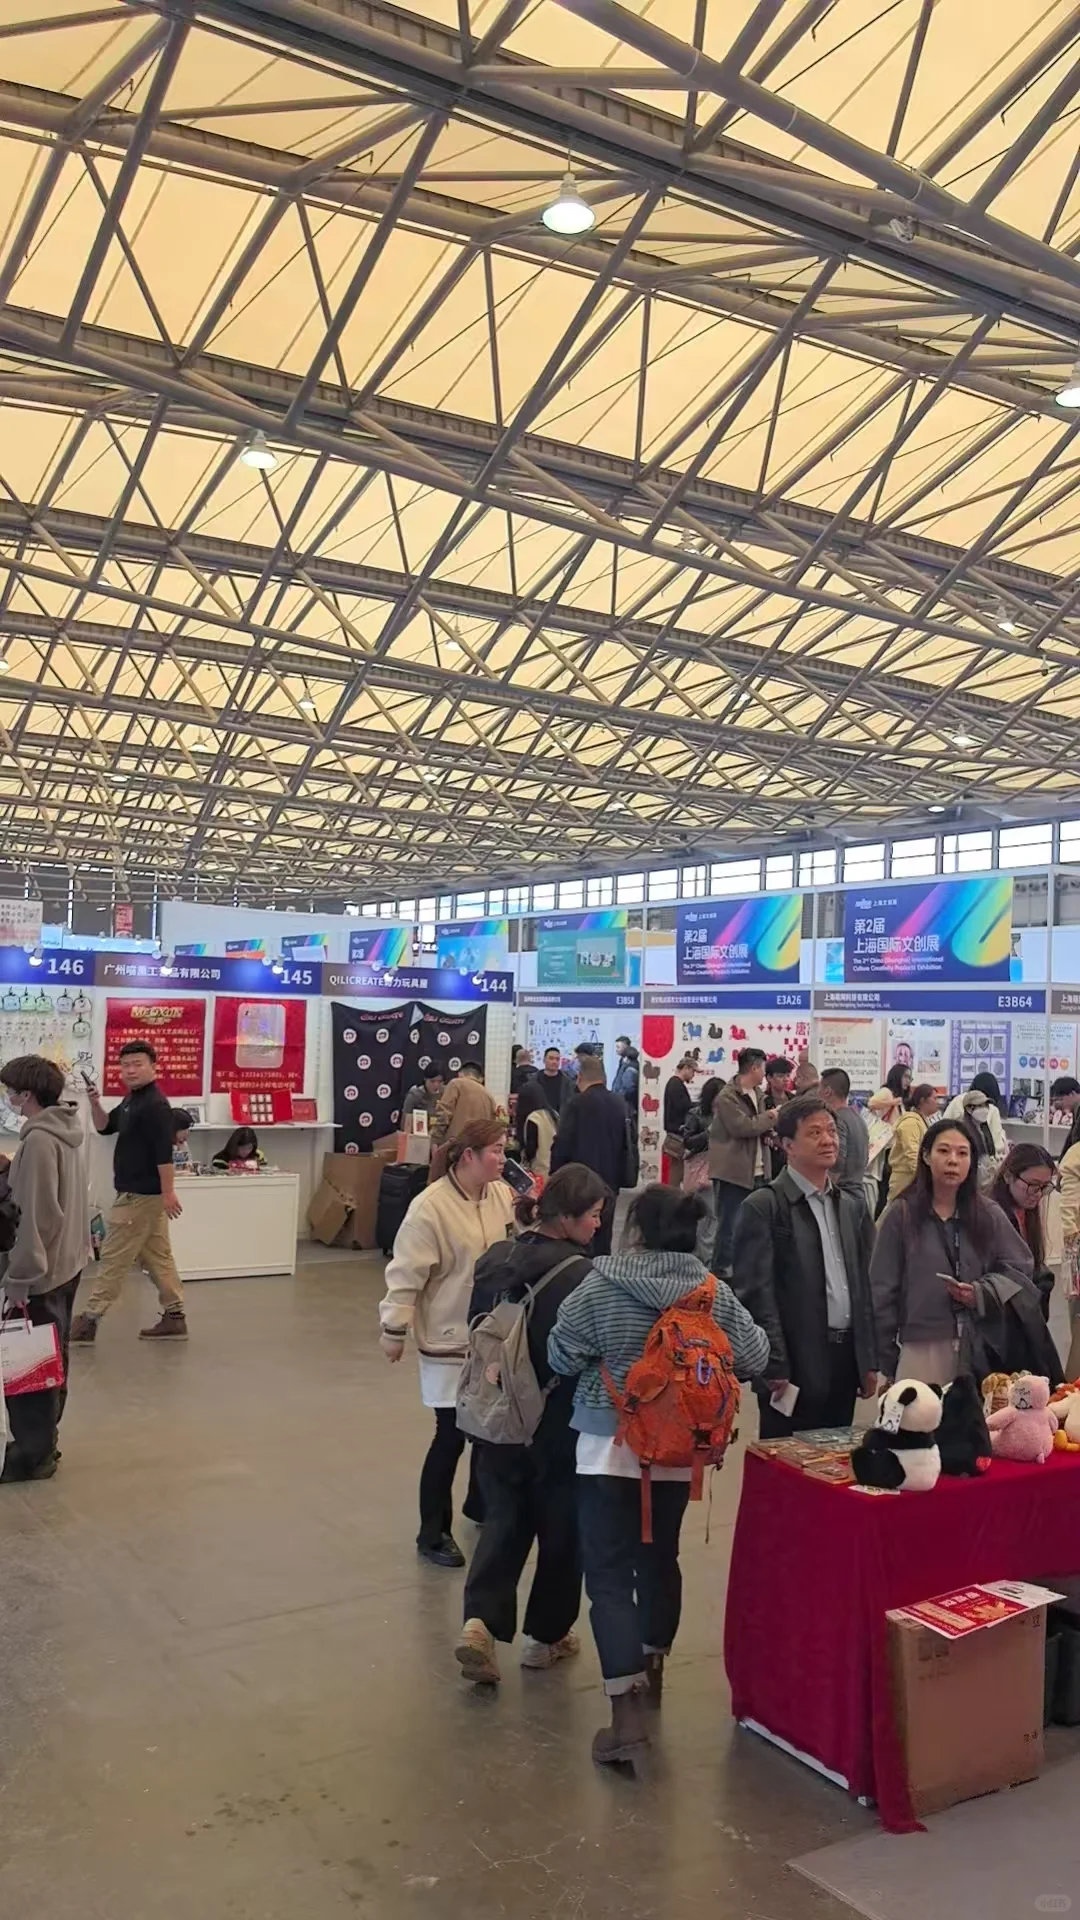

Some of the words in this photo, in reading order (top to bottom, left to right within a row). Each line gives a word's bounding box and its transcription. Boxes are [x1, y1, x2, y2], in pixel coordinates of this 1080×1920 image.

[854, 918, 885, 935] 第2届
[684, 929, 707, 943] 第2届
[853, 935, 940, 954] 上海国际文创展
[683, 944, 748, 960] 上海国际文创展
[47, 958, 84, 975] 146
[281, 970, 312, 984] 145
[480, 978, 507, 992] 144
[776, 995, 801, 1005] E3A26
[998, 996, 1032, 1008] E3B64
